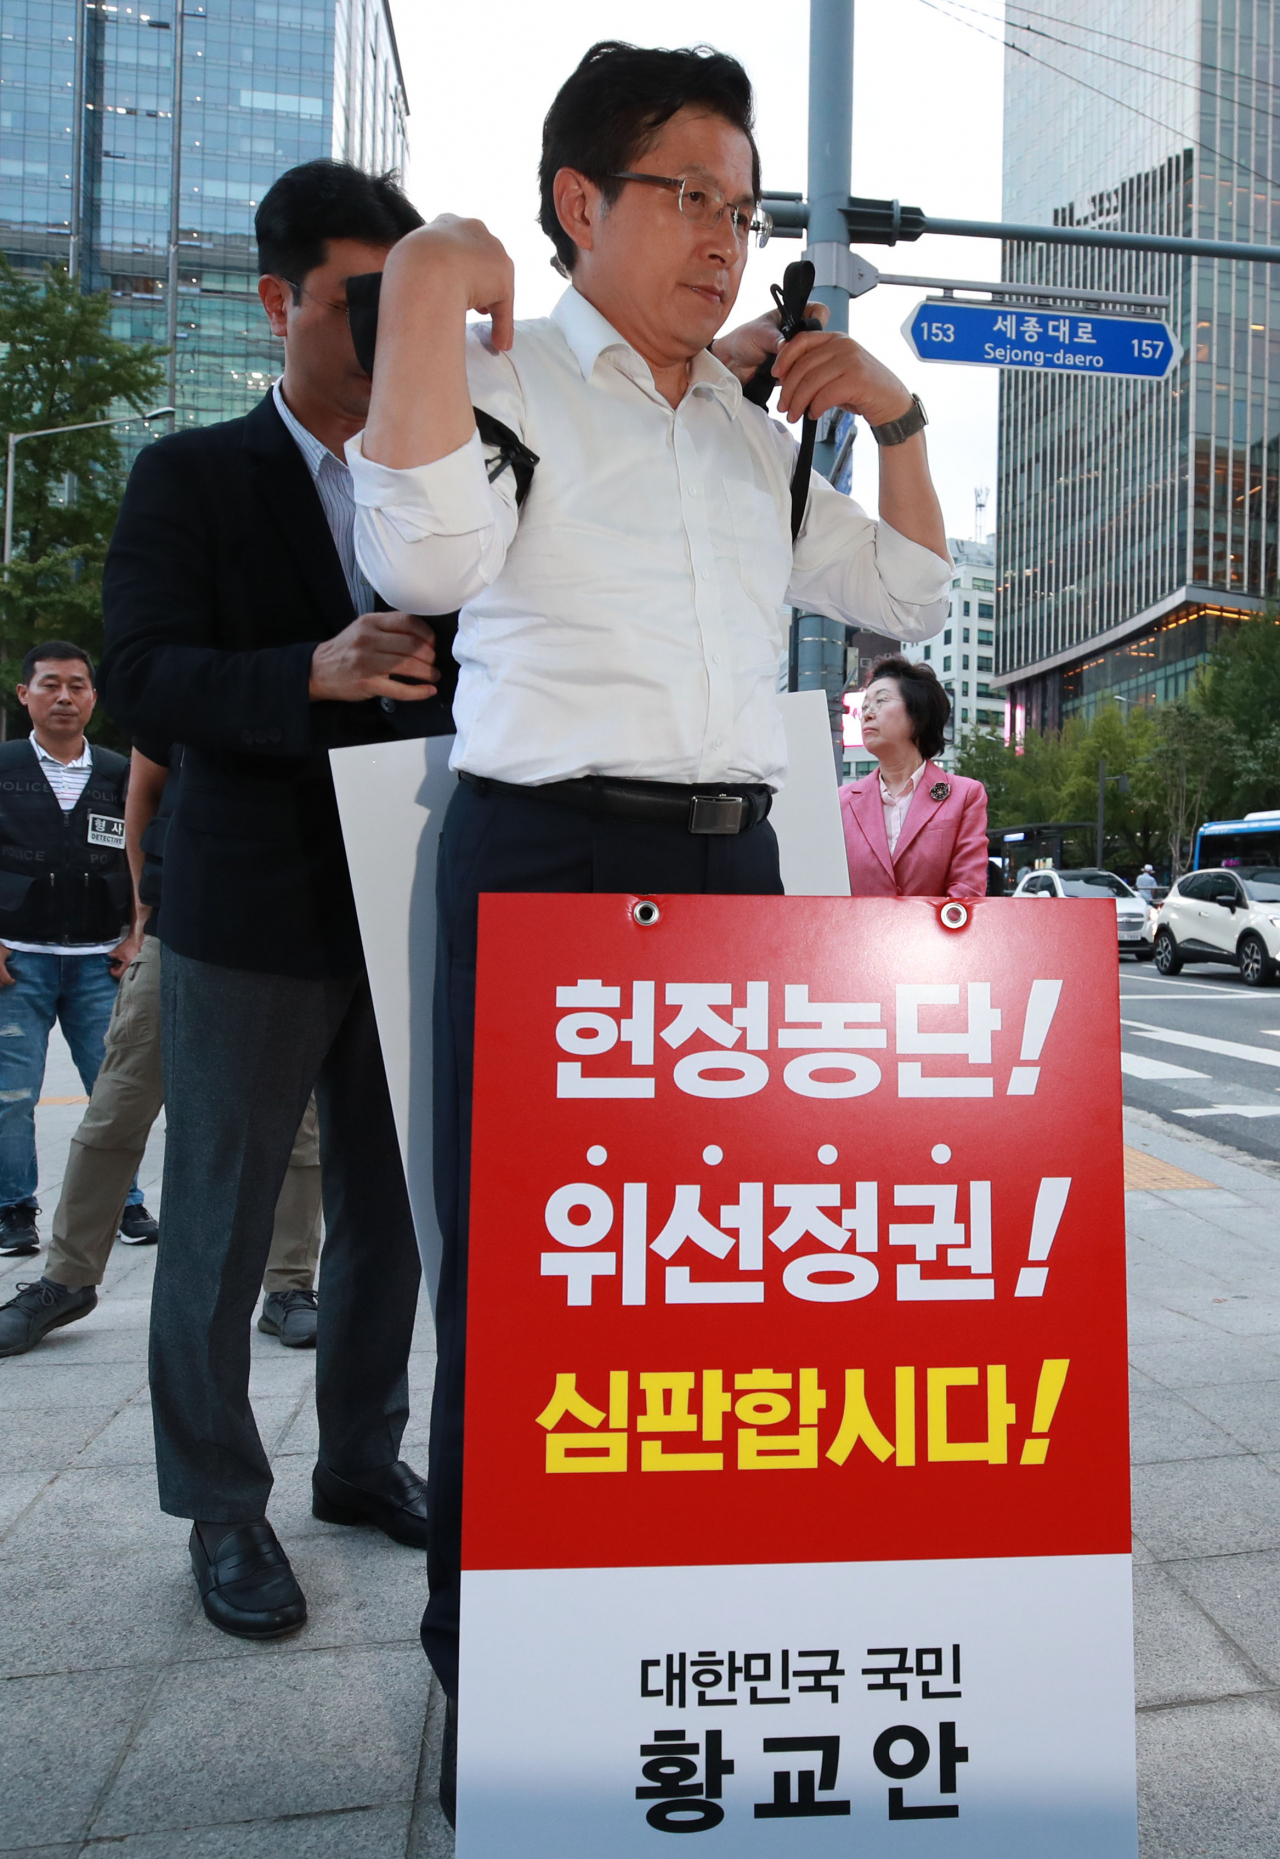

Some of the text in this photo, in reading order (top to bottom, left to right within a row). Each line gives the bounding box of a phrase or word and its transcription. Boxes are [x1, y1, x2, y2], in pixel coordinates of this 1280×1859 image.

[920, 321, 955, 343] 153
[992, 314, 1097, 344] 세종대로
[984, 342, 1104, 367] Sejong-daero
[1131, 338, 1165, 359] 157
[0, 781, 50, 793] OLICE
[91, 833, 123, 845] DETECTIVE
[554, 978, 1064, 1099] 헌정농단!
[534, 1358, 1071, 1474] 심판합시다!
[640, 1643, 962, 1709] 대한민국 국민
